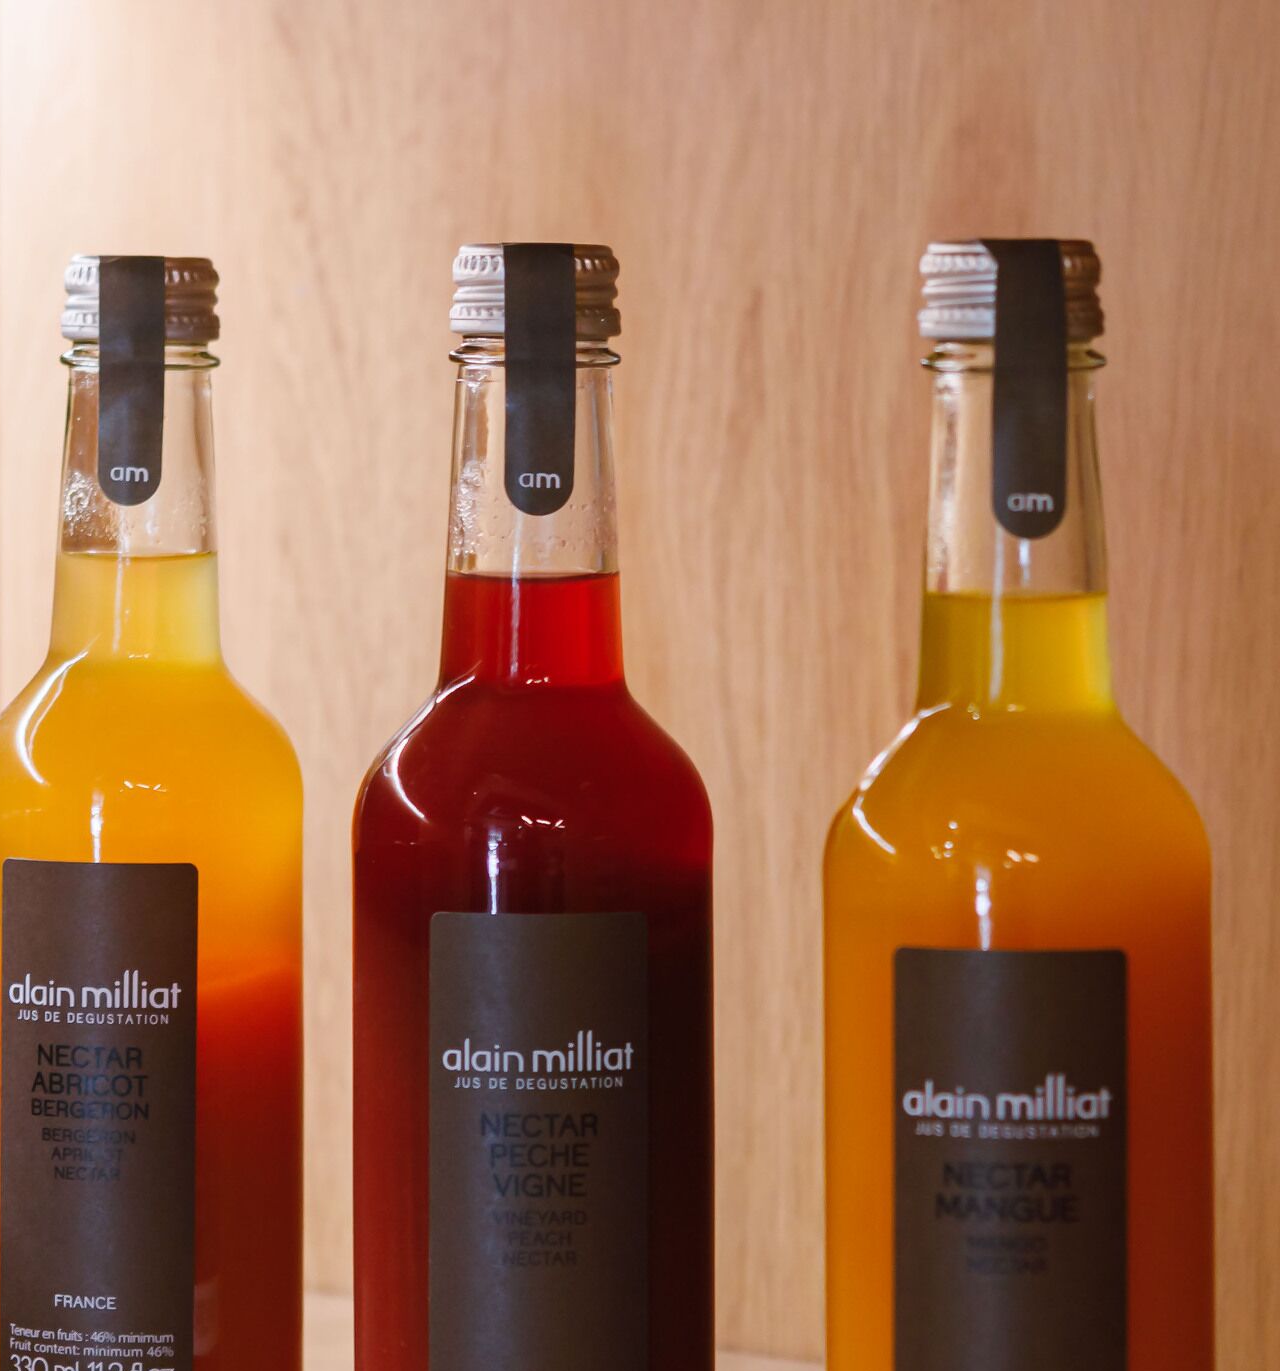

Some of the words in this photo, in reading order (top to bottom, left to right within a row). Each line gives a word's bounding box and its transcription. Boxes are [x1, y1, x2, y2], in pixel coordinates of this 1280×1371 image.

[110, 466, 149, 482] am
[518, 472, 561, 489] am
[1007, 492, 1054, 512] am
[9, 973, 75, 1008] alain
[81, 969, 182, 1010] milliat
[17, 1009, 39, 1021] JUS
[44, 1011, 61, 1023] DE
[67, 1012, 169, 1025] DEGUSTATION
[37, 1043, 143, 1069] NECTAR
[442, 1038, 524, 1073] alain
[532, 1029, 634, 1073] milliat
[31, 1072, 149, 1097] ABRICOT
[454, 1076, 481, 1089] JUS
[488, 1077, 508, 1090] DE
[515, 1076, 623, 1090] DEGUSTATION
[902, 1078, 990, 1120] alain
[996, 1073, 1112, 1121] milliat
[31, 1098, 149, 1120] BERGERON
[480, 1112, 599, 1138] NECTAR
[51, 1147, 123, 1162] APRIT
[490, 1142, 590, 1168] PECHE
[493, 1173, 587, 1198] VIGNE
[943, 1162, 1072, 1190] NECTAR
[935, 1193, 1079, 1223] MANGUE
[54, 1294, 117, 1310] FRANCE
[9, 1323, 40, 1339] Teneur
[42, 1330, 55, 1340] en
[57, 1328, 83, 1342] fruits
[118, 1332, 174, 1344] minimum
[9, 1338, 31, 1351] Fruit
[83, 1345, 143, 1357] minimum
